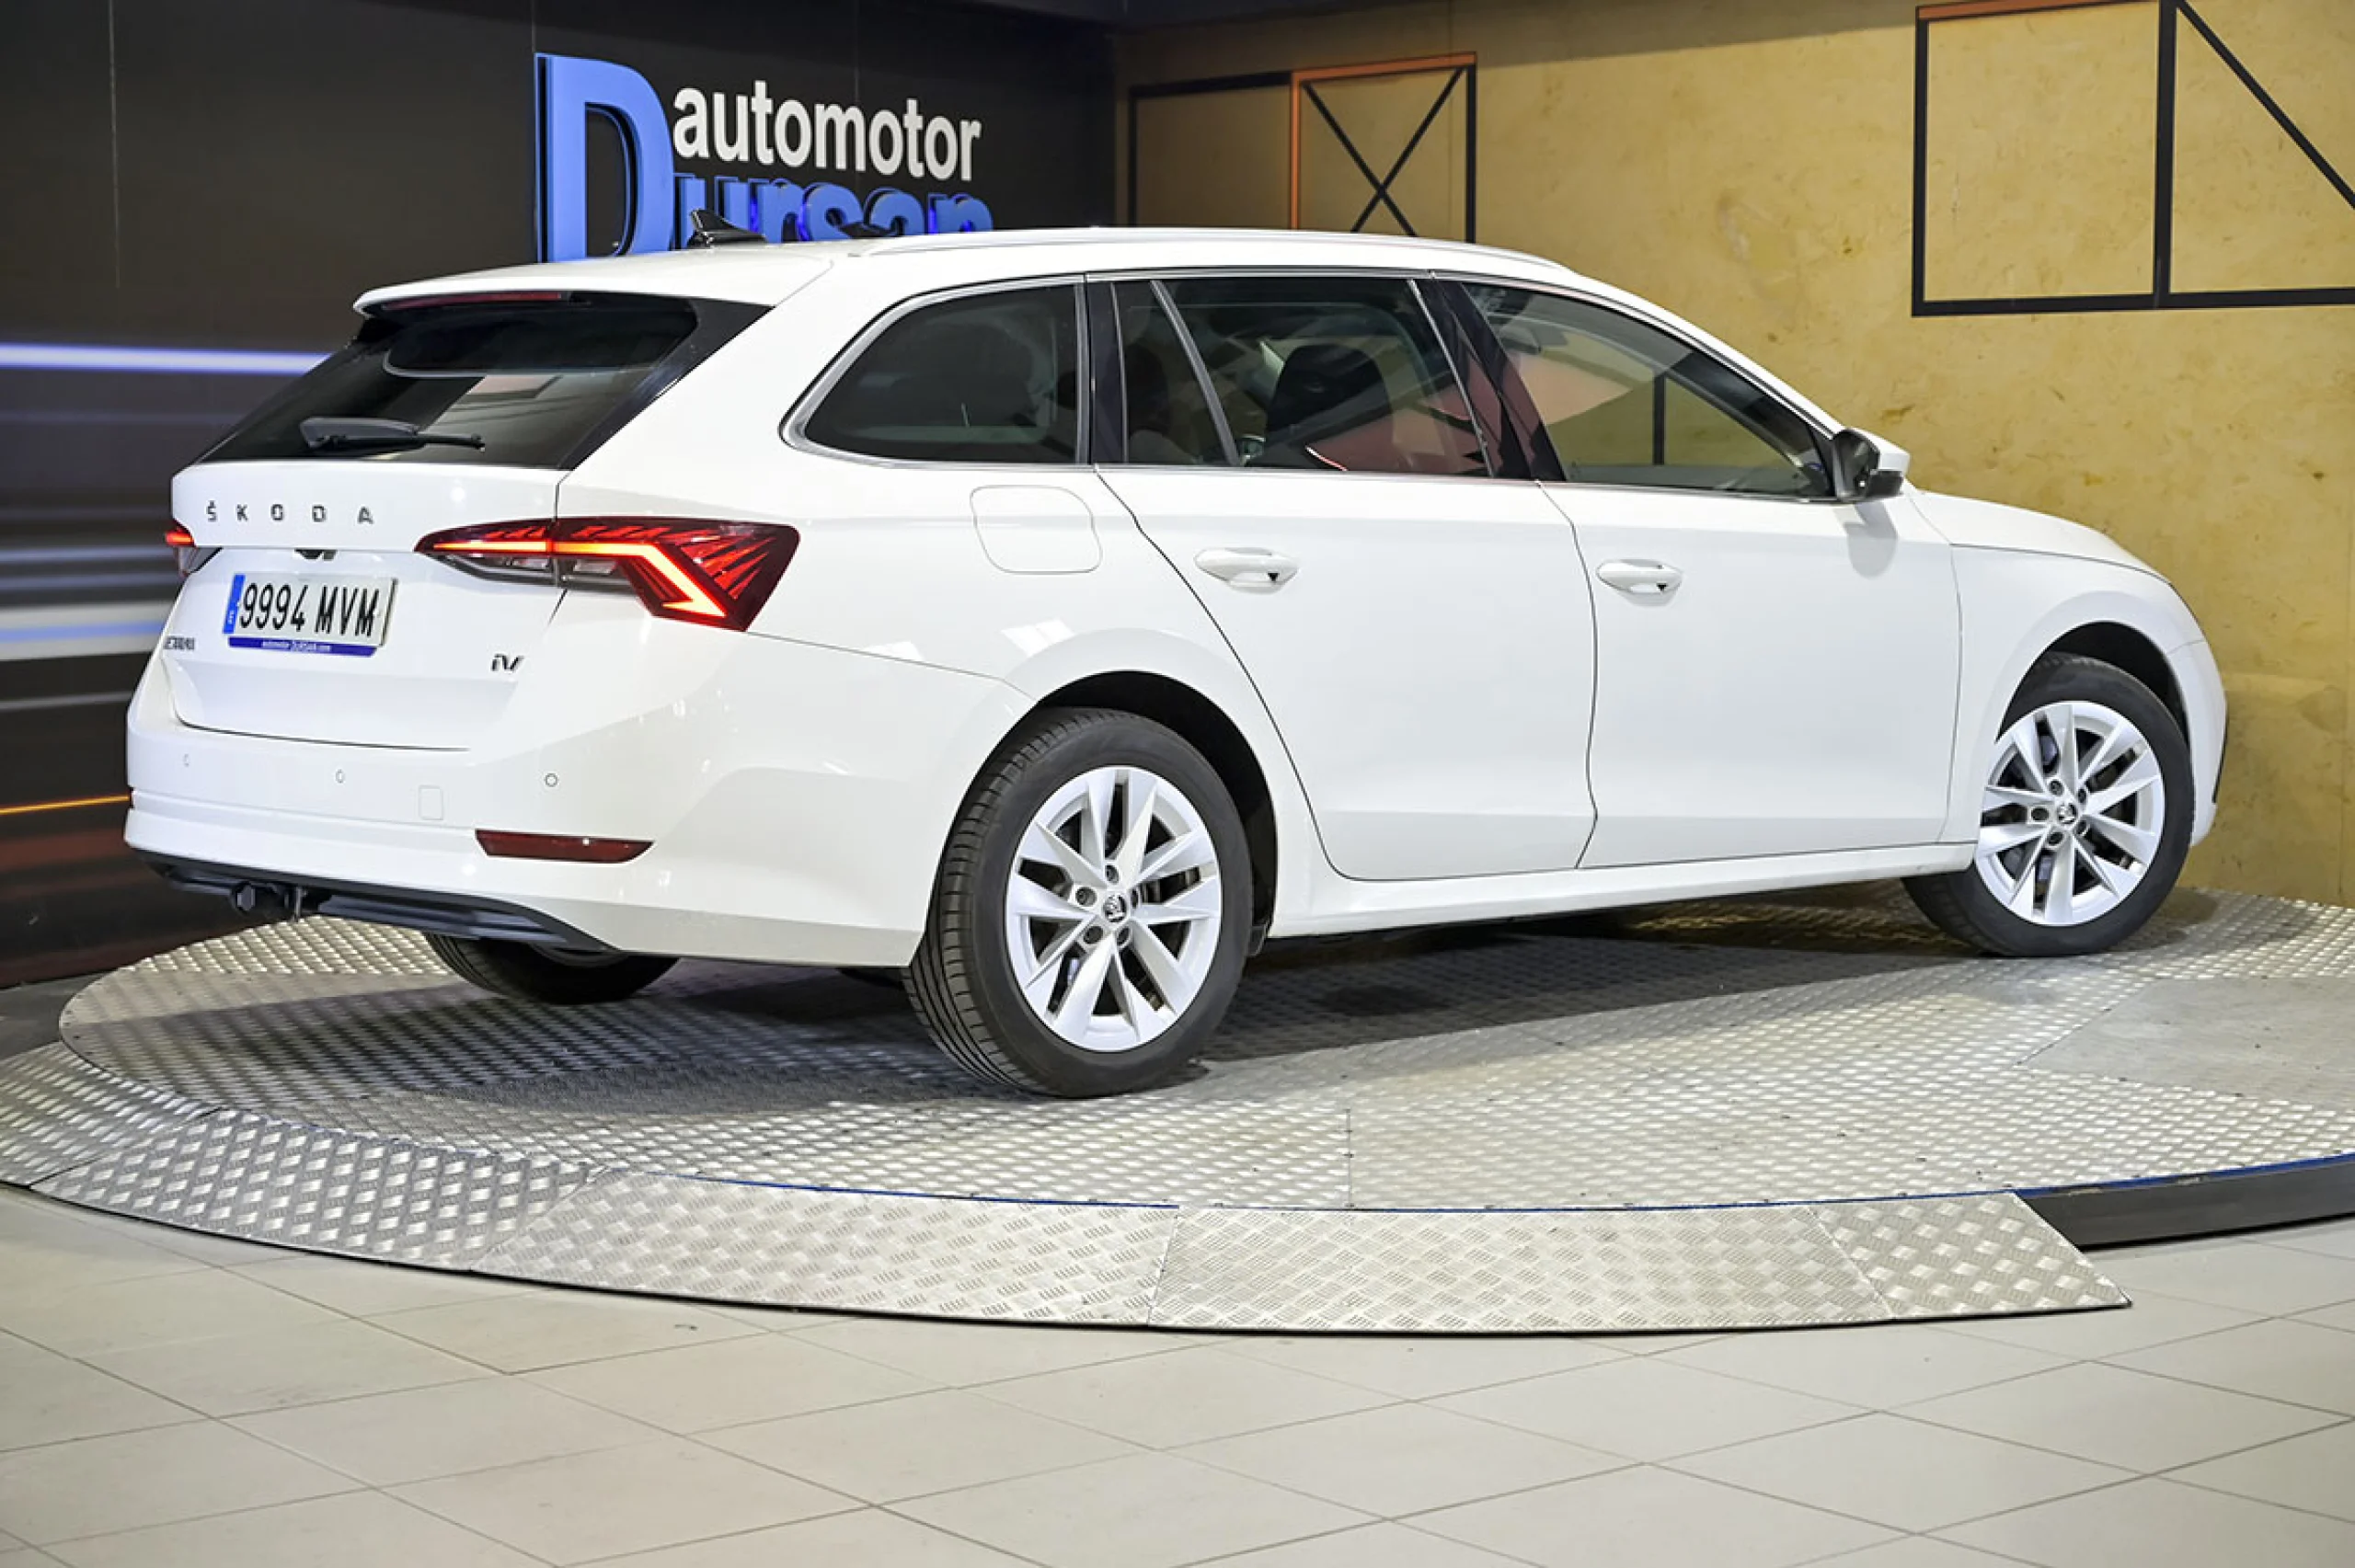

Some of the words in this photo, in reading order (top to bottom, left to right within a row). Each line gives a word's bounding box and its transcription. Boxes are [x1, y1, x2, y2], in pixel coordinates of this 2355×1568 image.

[673, 79, 982, 181] automotor
[205, 499, 374, 525] ŠKODA
[239, 581, 309, 632] 9994
[314, 584, 380, 637] MVM
